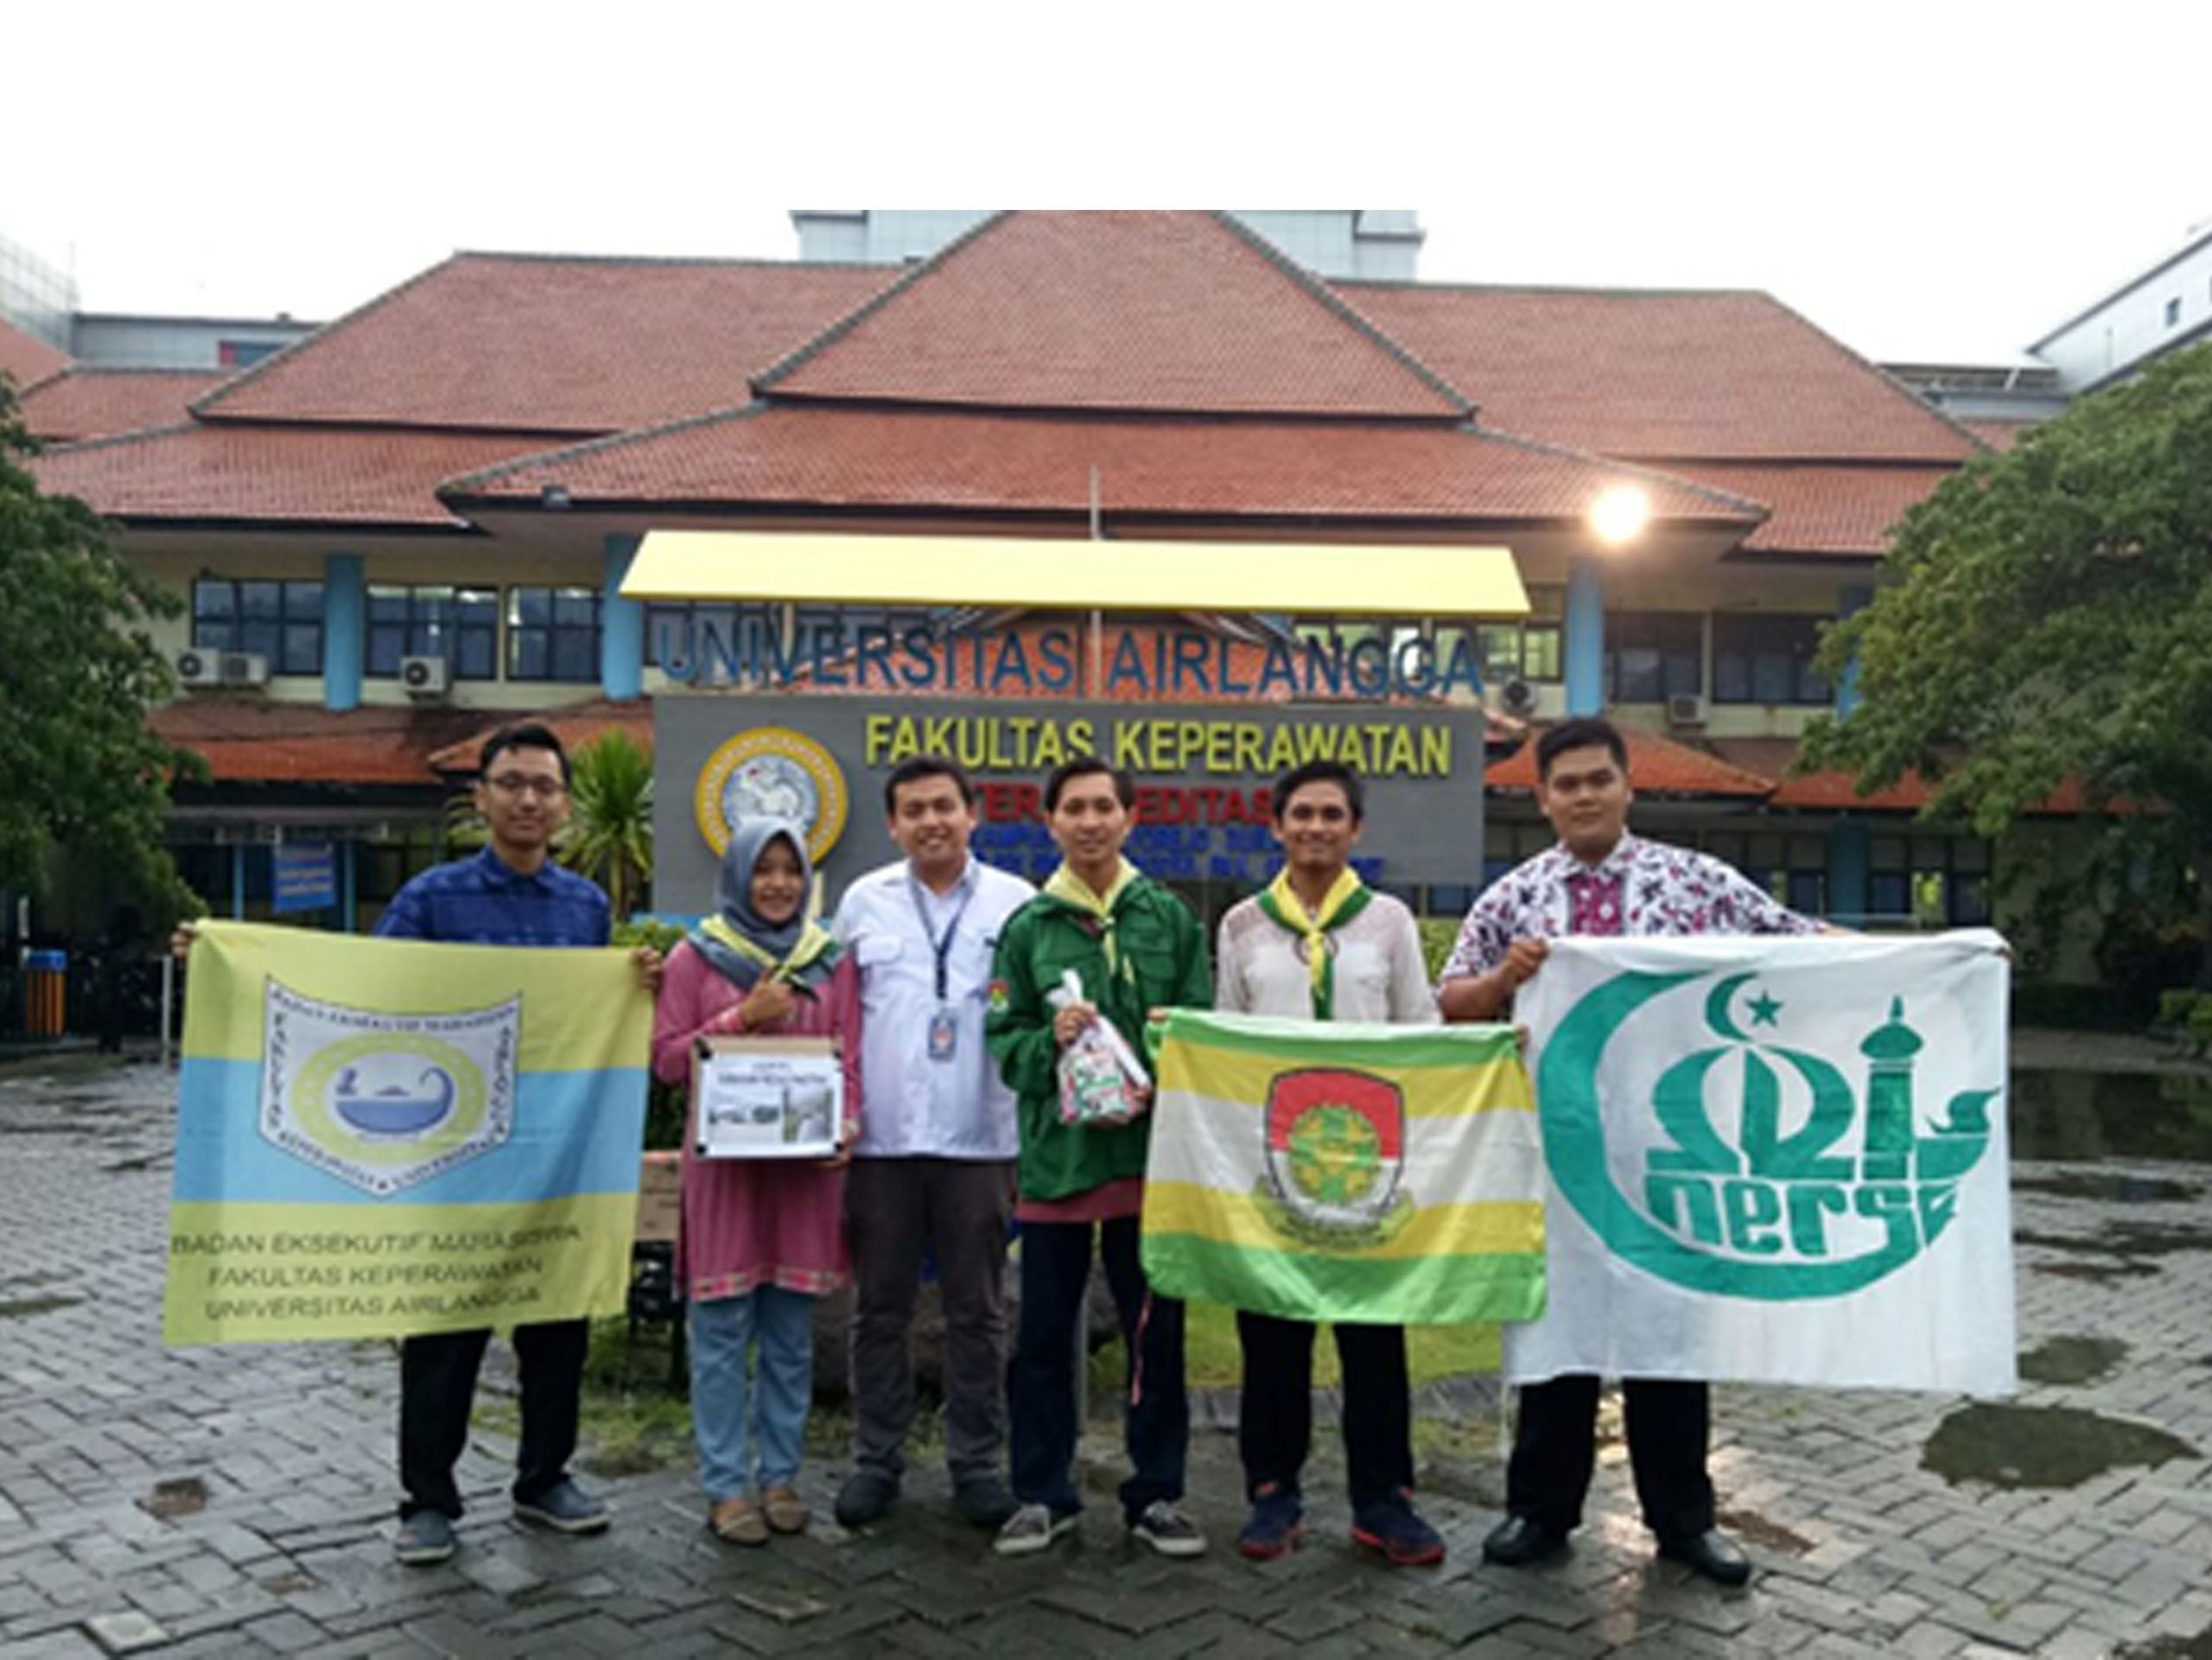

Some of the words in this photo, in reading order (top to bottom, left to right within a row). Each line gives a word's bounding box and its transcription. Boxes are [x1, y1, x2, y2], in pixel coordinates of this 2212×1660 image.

[660, 615, 1072, 690] UNIVERSITAS
[1107, 629, 1485, 698] AIRLANGGA
[865, 715, 1095, 768] FAKULTAS
[1115, 720, 1452, 776] KEPERAWATAN
[171, 1232, 266, 1256] BADAN
[271, 1230, 427, 1256] EKSEKUTIF
[207, 1266, 343, 1288] FAKULTAS
[204, 1294, 383, 1321] UNIVERSITAS
